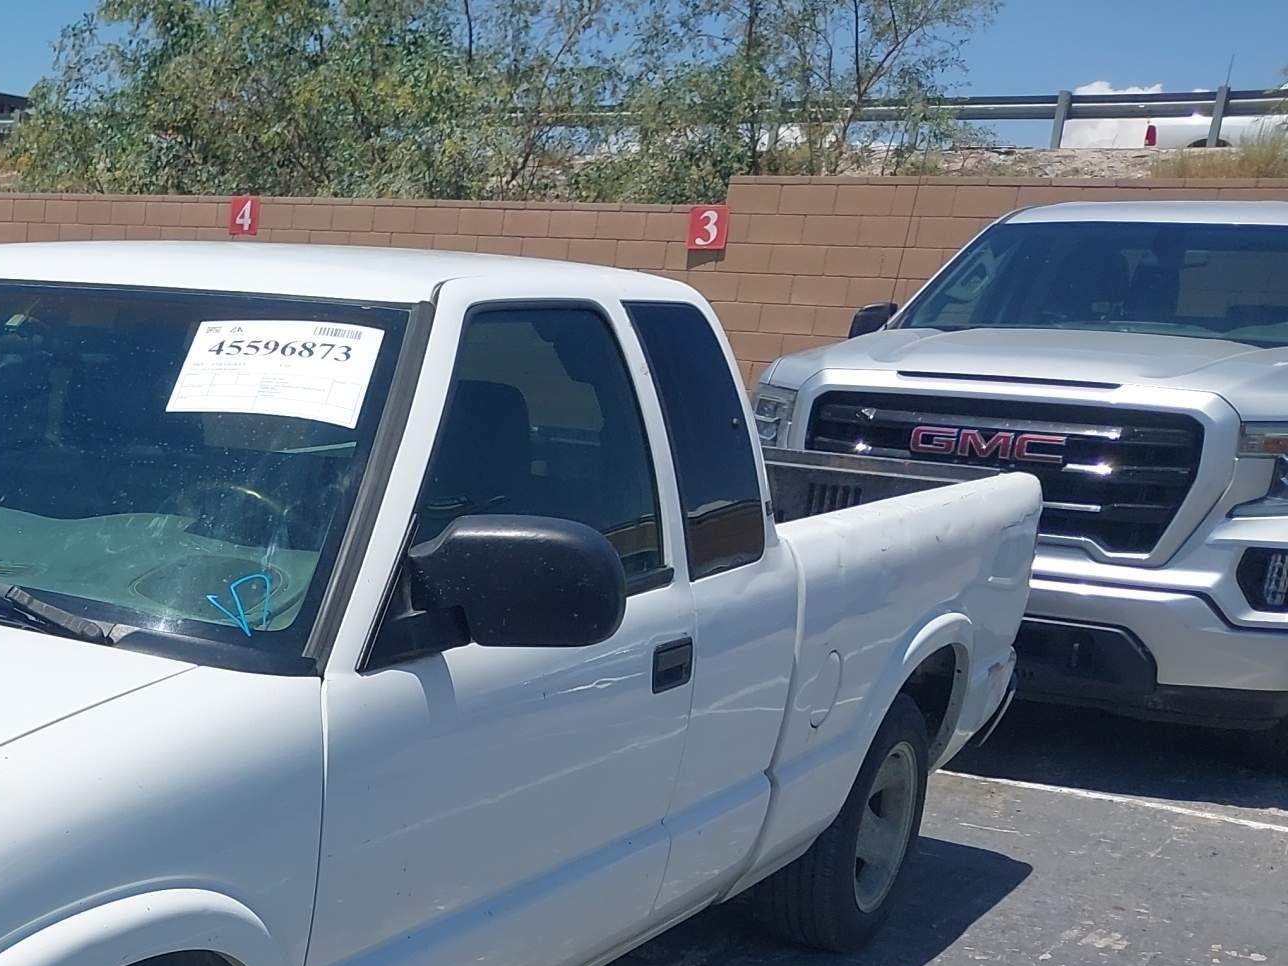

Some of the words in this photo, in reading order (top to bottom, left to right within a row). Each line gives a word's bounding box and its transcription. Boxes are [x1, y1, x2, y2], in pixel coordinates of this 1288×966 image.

[235, 199, 252, 231] 4
[695, 210, 718, 246] 3
[208, 339, 353, 362] 45596873
[910, 425, 1068, 464] GMC
